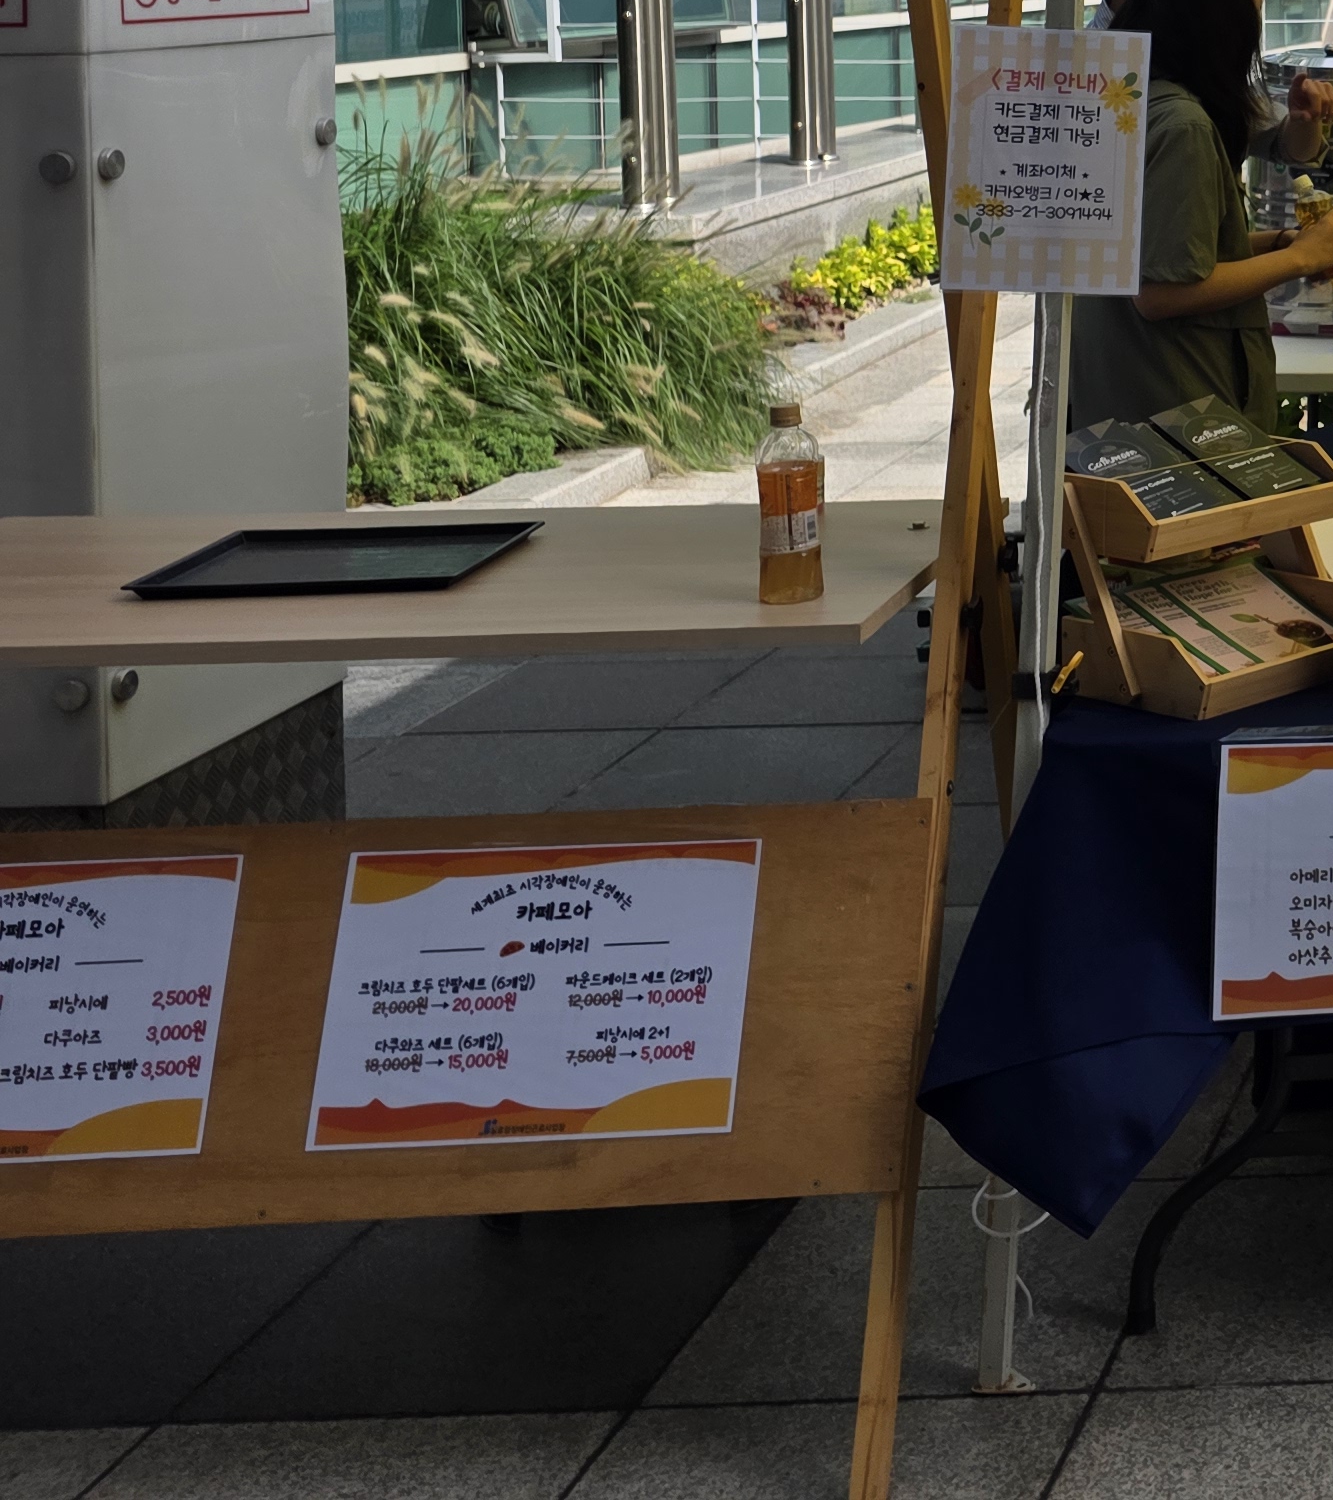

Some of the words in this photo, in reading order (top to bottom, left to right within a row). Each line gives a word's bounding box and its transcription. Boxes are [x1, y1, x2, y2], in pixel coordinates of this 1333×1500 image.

[994, 102, 1060, 121] 카드결제
[1066, 104, 1100, 125] 가능!
[993, 124, 1059, 144] 현금결제
[1066, 128, 1100, 147] 가능!
[1012, 164, 1076, 180] 계좌이체
[985, 185, 1052, 200] 카카오뱅크
[976, 205, 1112, 221] 3333-21-3091494
[516, 900, 593, 923] 카페모아
[529, 937, 589, 954] 베이커리
[357, 979, 405, 996] 크림치즈
[491, 972, 536, 992] (6개입)
[565, 971, 638, 988] 파운드케이크
[670, 966, 713, 985] (2개입)
[49, 994, 109, 1014] 피낭시에
[152, 984, 212, 1010] 2,500원
[452, 991, 518, 1016] 20,000원
[646, 984, 707, 1006] 10,000원
[44, 1029, 102, 1048] 다쿠아즈
[146, 1020, 207, 1045] 3,000원
[458, 1032, 504, 1051] (6개입)
[648, 1026, 671, 1041] 2+1
[447, 1048, 509, 1071] 15,000원
[640, 1041, 696, 1062] 5,000원
[58, 1062, 88, 1081] 호두
[92, 1058, 138, 1080] 단팥빵
[141, 1055, 202, 1081] 3,500원
